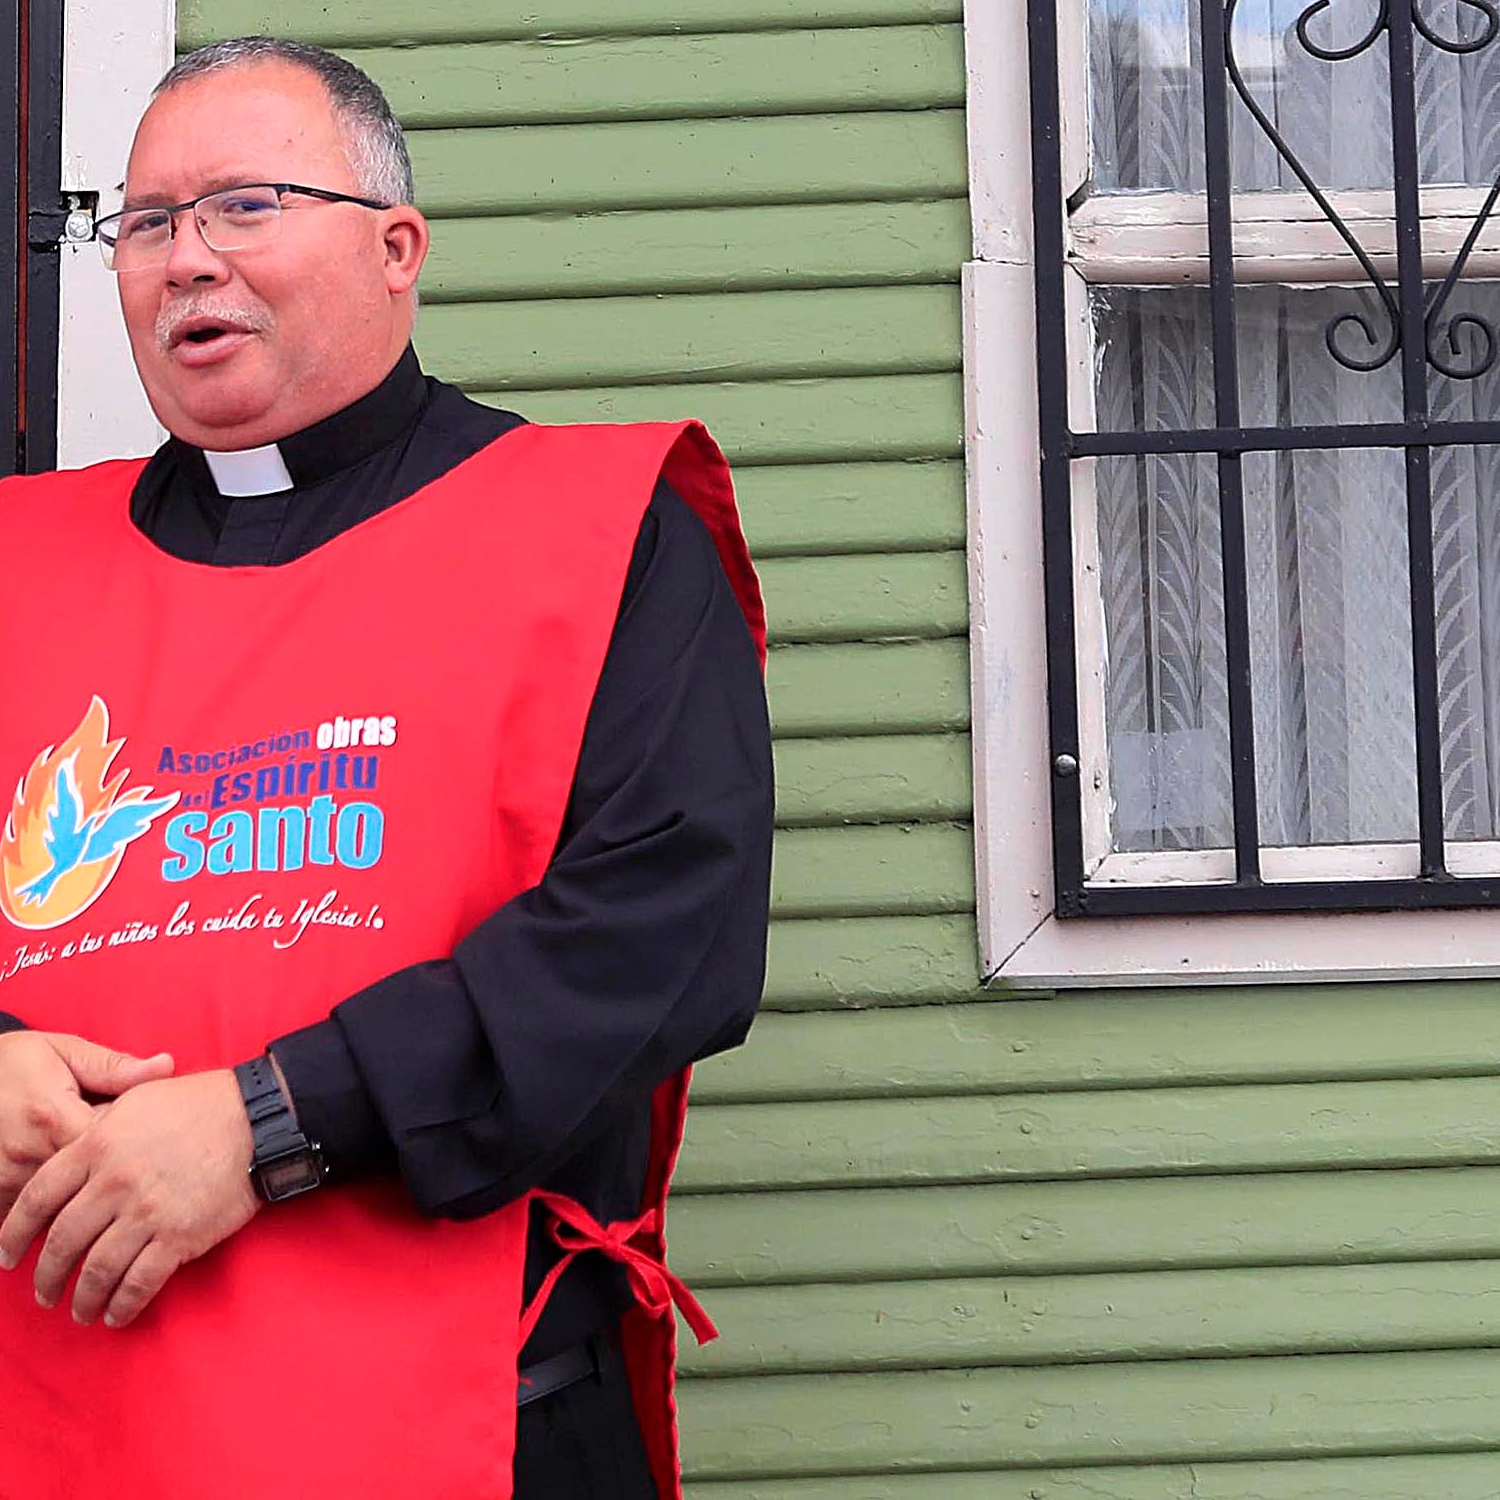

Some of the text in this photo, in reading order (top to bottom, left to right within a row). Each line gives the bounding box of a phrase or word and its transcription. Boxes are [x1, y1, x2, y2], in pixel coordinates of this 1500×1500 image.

[316, 715, 397, 750] obras
[211, 753, 379, 810] Espíritu
[162, 794, 385, 882] santo
[61, 941, 77, 958] a
[108, 921, 159, 946] niños
[165, 900, 196, 937] los
[202, 893, 263, 932] cuida
[263, 908, 285, 929] tu
